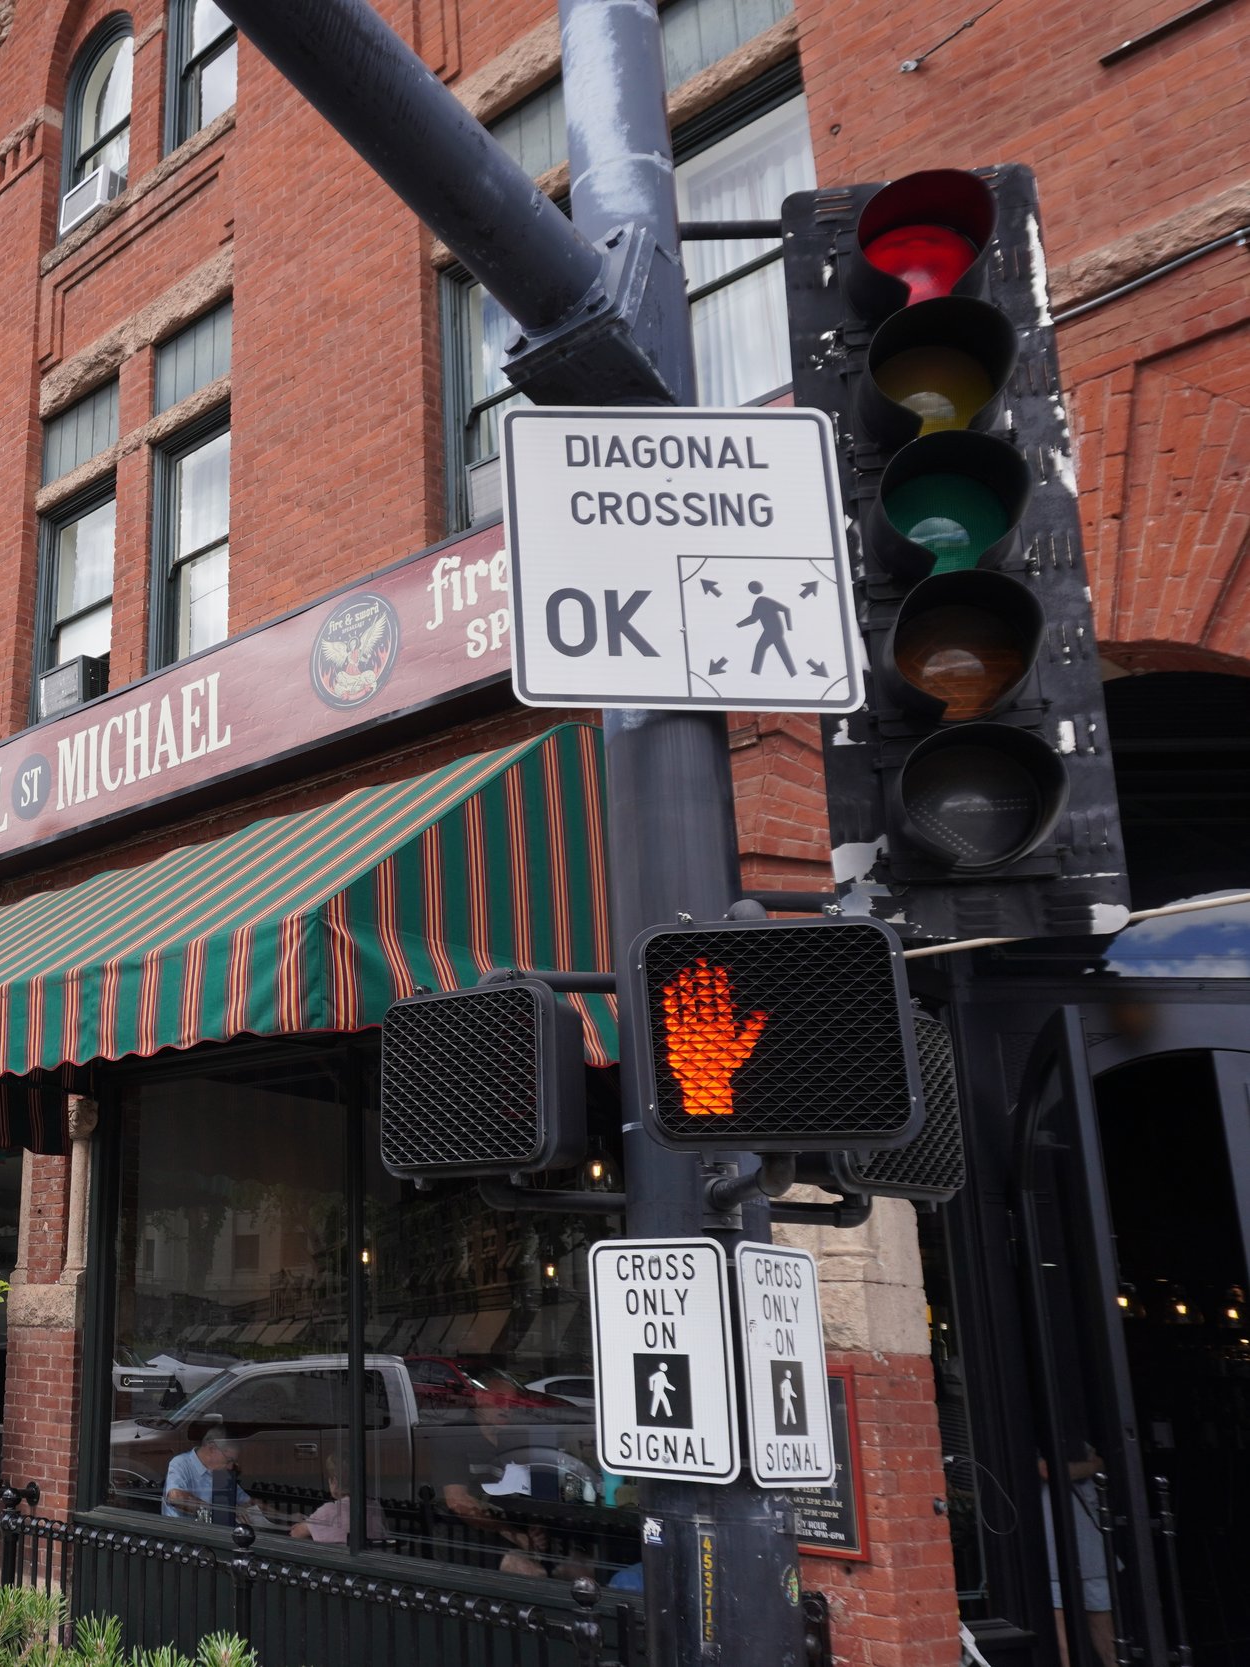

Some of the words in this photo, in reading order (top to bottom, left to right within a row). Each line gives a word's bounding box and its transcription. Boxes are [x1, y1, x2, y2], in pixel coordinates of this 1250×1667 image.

[564, 434, 769, 470] DIAGONAL
[570, 490, 775, 528] CROSSING
[426, 549, 509, 631] fire
[328, 618, 343, 635] fire
[344, 613, 354, 627] &
[354, 601, 380, 622] sword
[545, 587, 662, 658] OK
[20, 764, 43, 808] ST
[55, 671, 232, 811] MICHAEL
[616, 1253, 696, 1281] CROSS
[754, 1257, 803, 1290] CROSS
[625, 1288, 689, 1316] ONLY
[762, 1293, 800, 1324] ONLY
[643, 1321, 677, 1349] ON
[775, 1328, 796, 1357] ON
[619, 1432, 716, 1467] SIGNAL
[766, 1442, 823, 1473] SIGNAL
[808, 1520, 828, 1531] HOUR
[813, 1529, 846, 1541] 4PM-6PM
